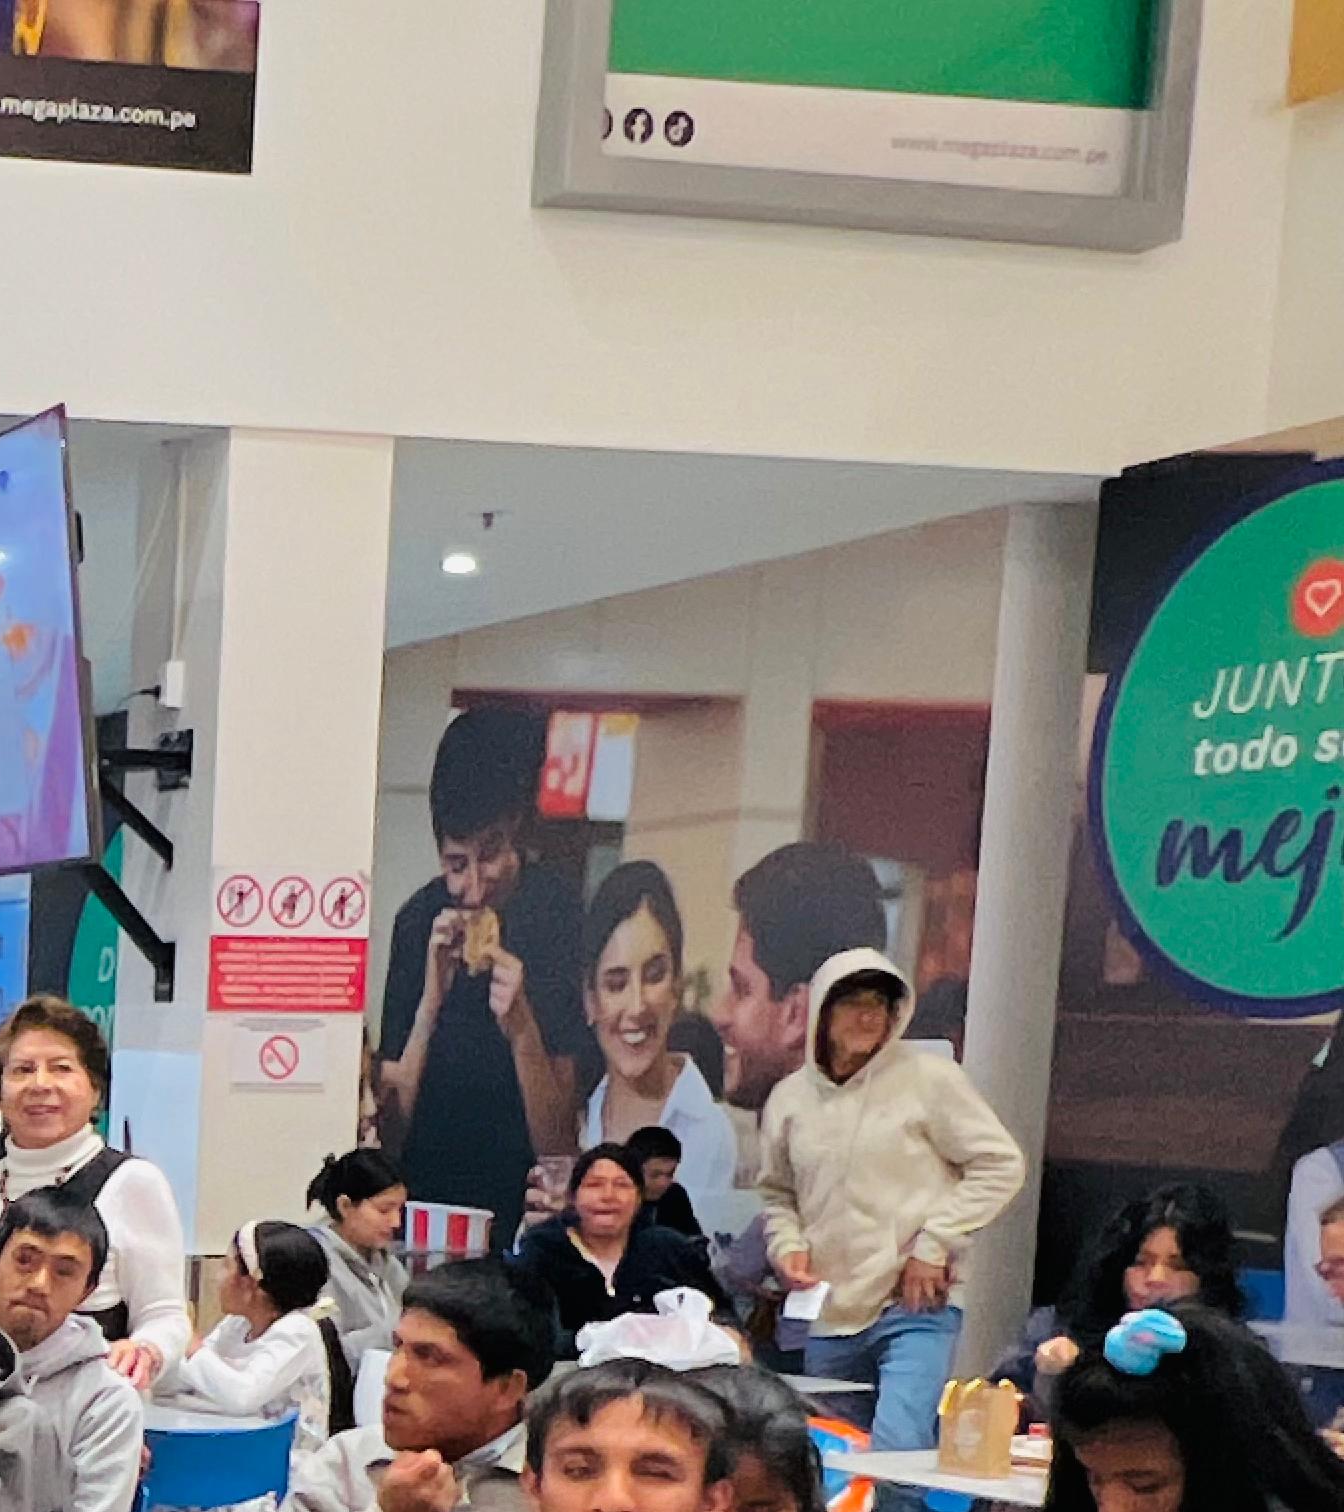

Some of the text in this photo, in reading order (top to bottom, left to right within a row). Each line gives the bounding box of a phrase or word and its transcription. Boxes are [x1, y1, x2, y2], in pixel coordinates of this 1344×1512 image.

[1193, 724, 1344, 777] todo s
[1156, 786, 1344, 943] mej
